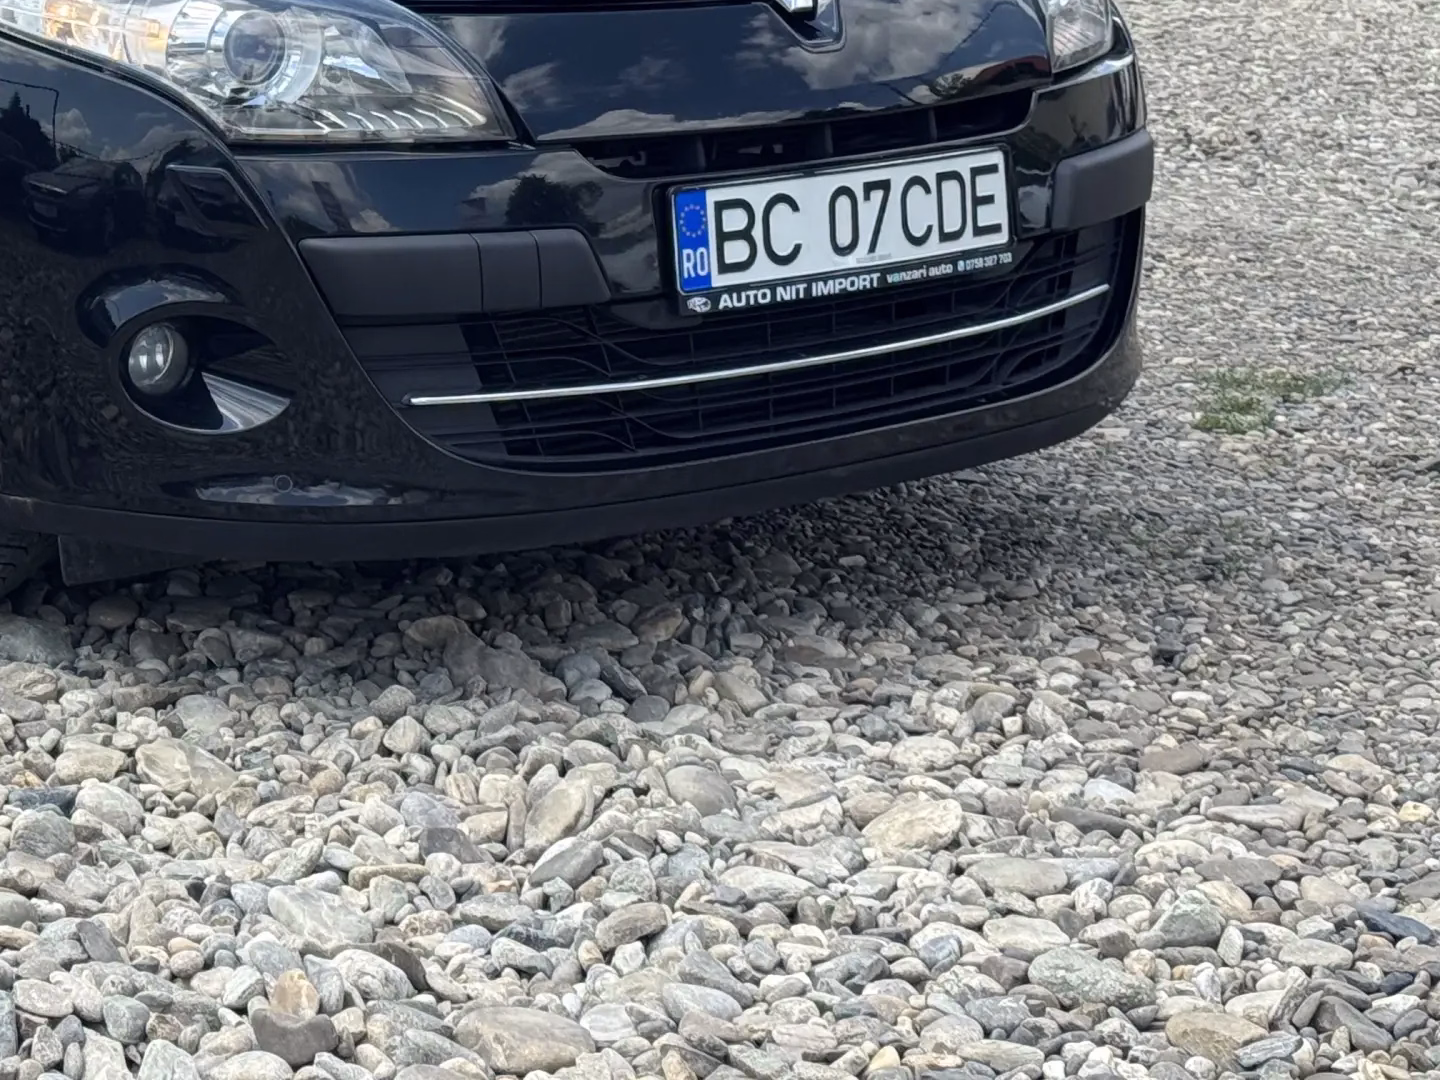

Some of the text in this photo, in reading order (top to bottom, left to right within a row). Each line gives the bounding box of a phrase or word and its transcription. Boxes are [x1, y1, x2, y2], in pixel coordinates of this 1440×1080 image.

[714, 193, 803, 274] BC
[682, 247, 708, 279] RO
[718, 288, 771, 310] AUTO
[776, 283, 807, 302] NIT
[811, 273, 881, 297] IMPORT
[886, 265, 927, 284] vanzari
[929, 262, 953, 277] auto
